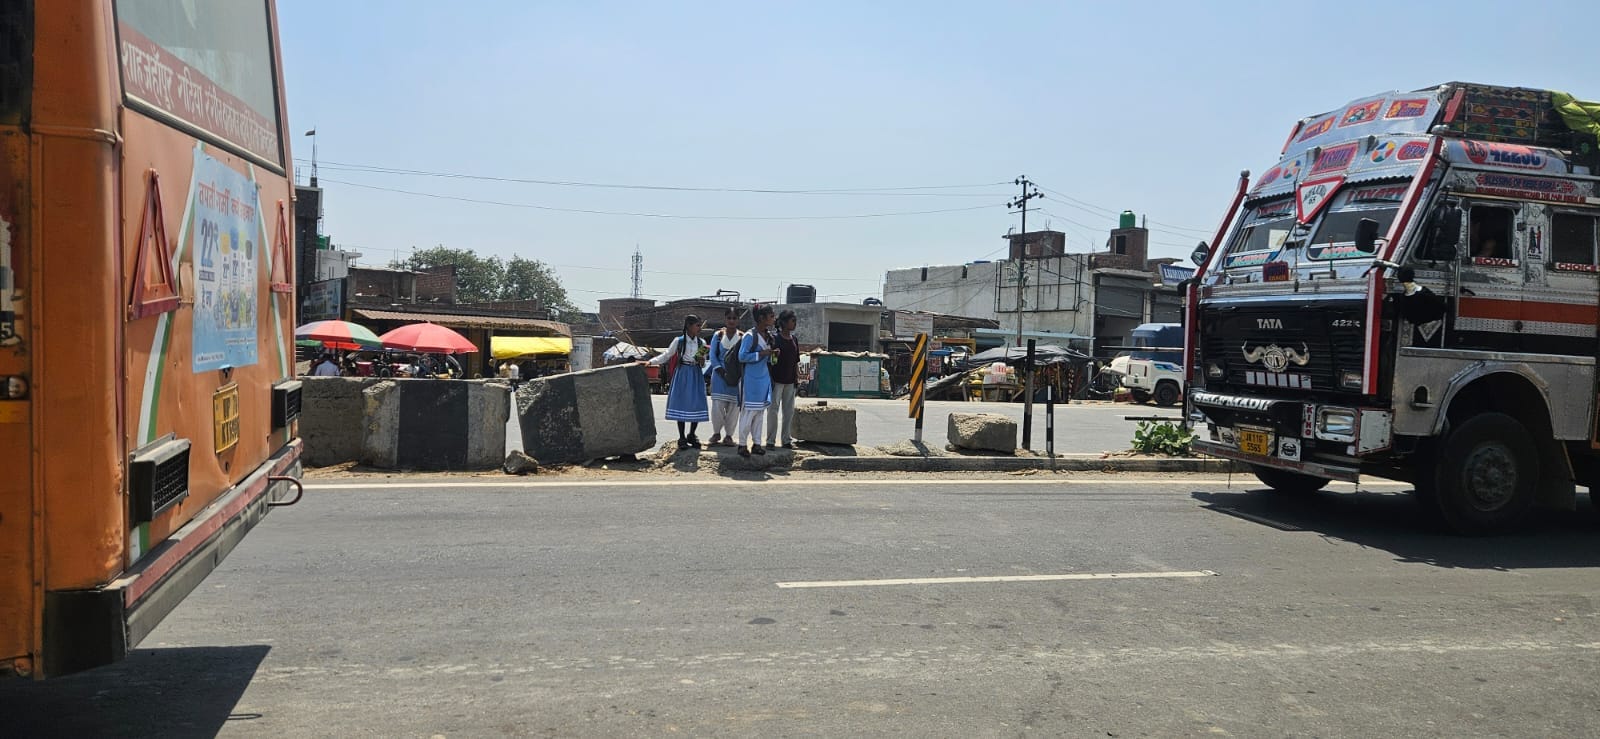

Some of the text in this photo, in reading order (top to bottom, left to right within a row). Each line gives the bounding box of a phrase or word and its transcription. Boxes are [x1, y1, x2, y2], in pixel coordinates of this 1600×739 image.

[1475, 257, 1517, 267] ROYAL
[1163, 267, 1194, 280] LUMINOU
[1257, 318, 1283, 329] TATA
